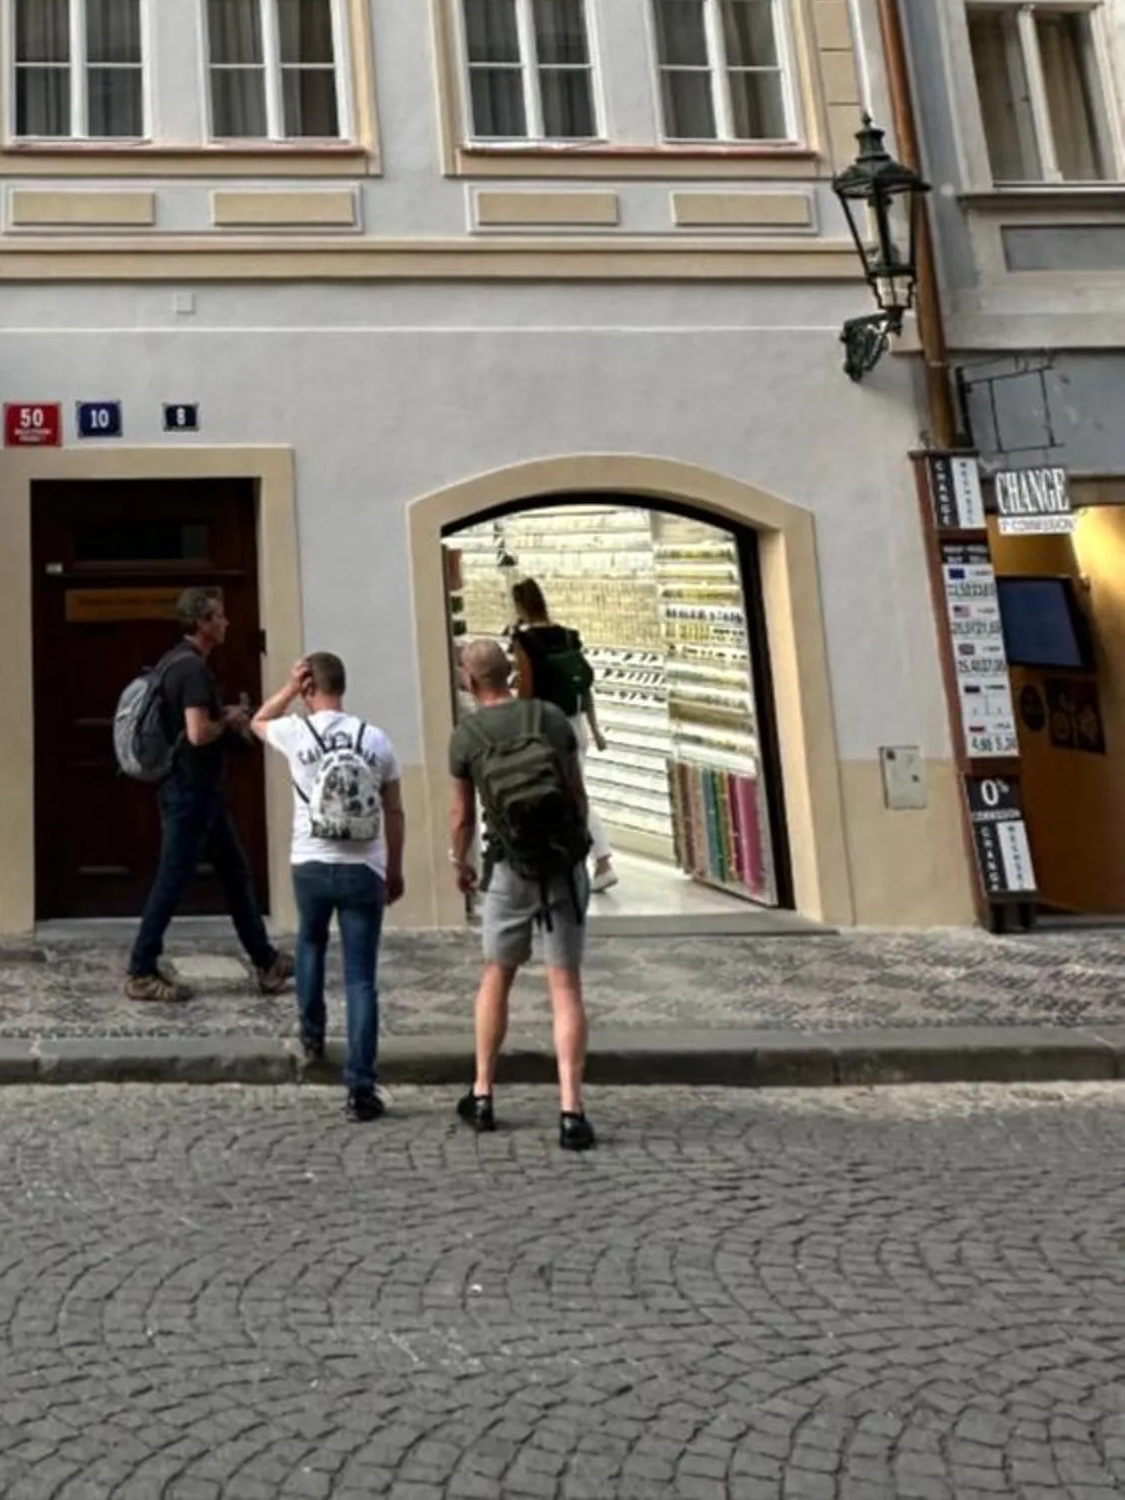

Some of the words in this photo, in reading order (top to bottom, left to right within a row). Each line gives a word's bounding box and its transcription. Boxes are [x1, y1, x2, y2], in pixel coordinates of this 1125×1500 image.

[19, 407, 44, 428] 50
[90, 408, 110, 429] 10
[995, 467, 1070, 514] CHANGE
